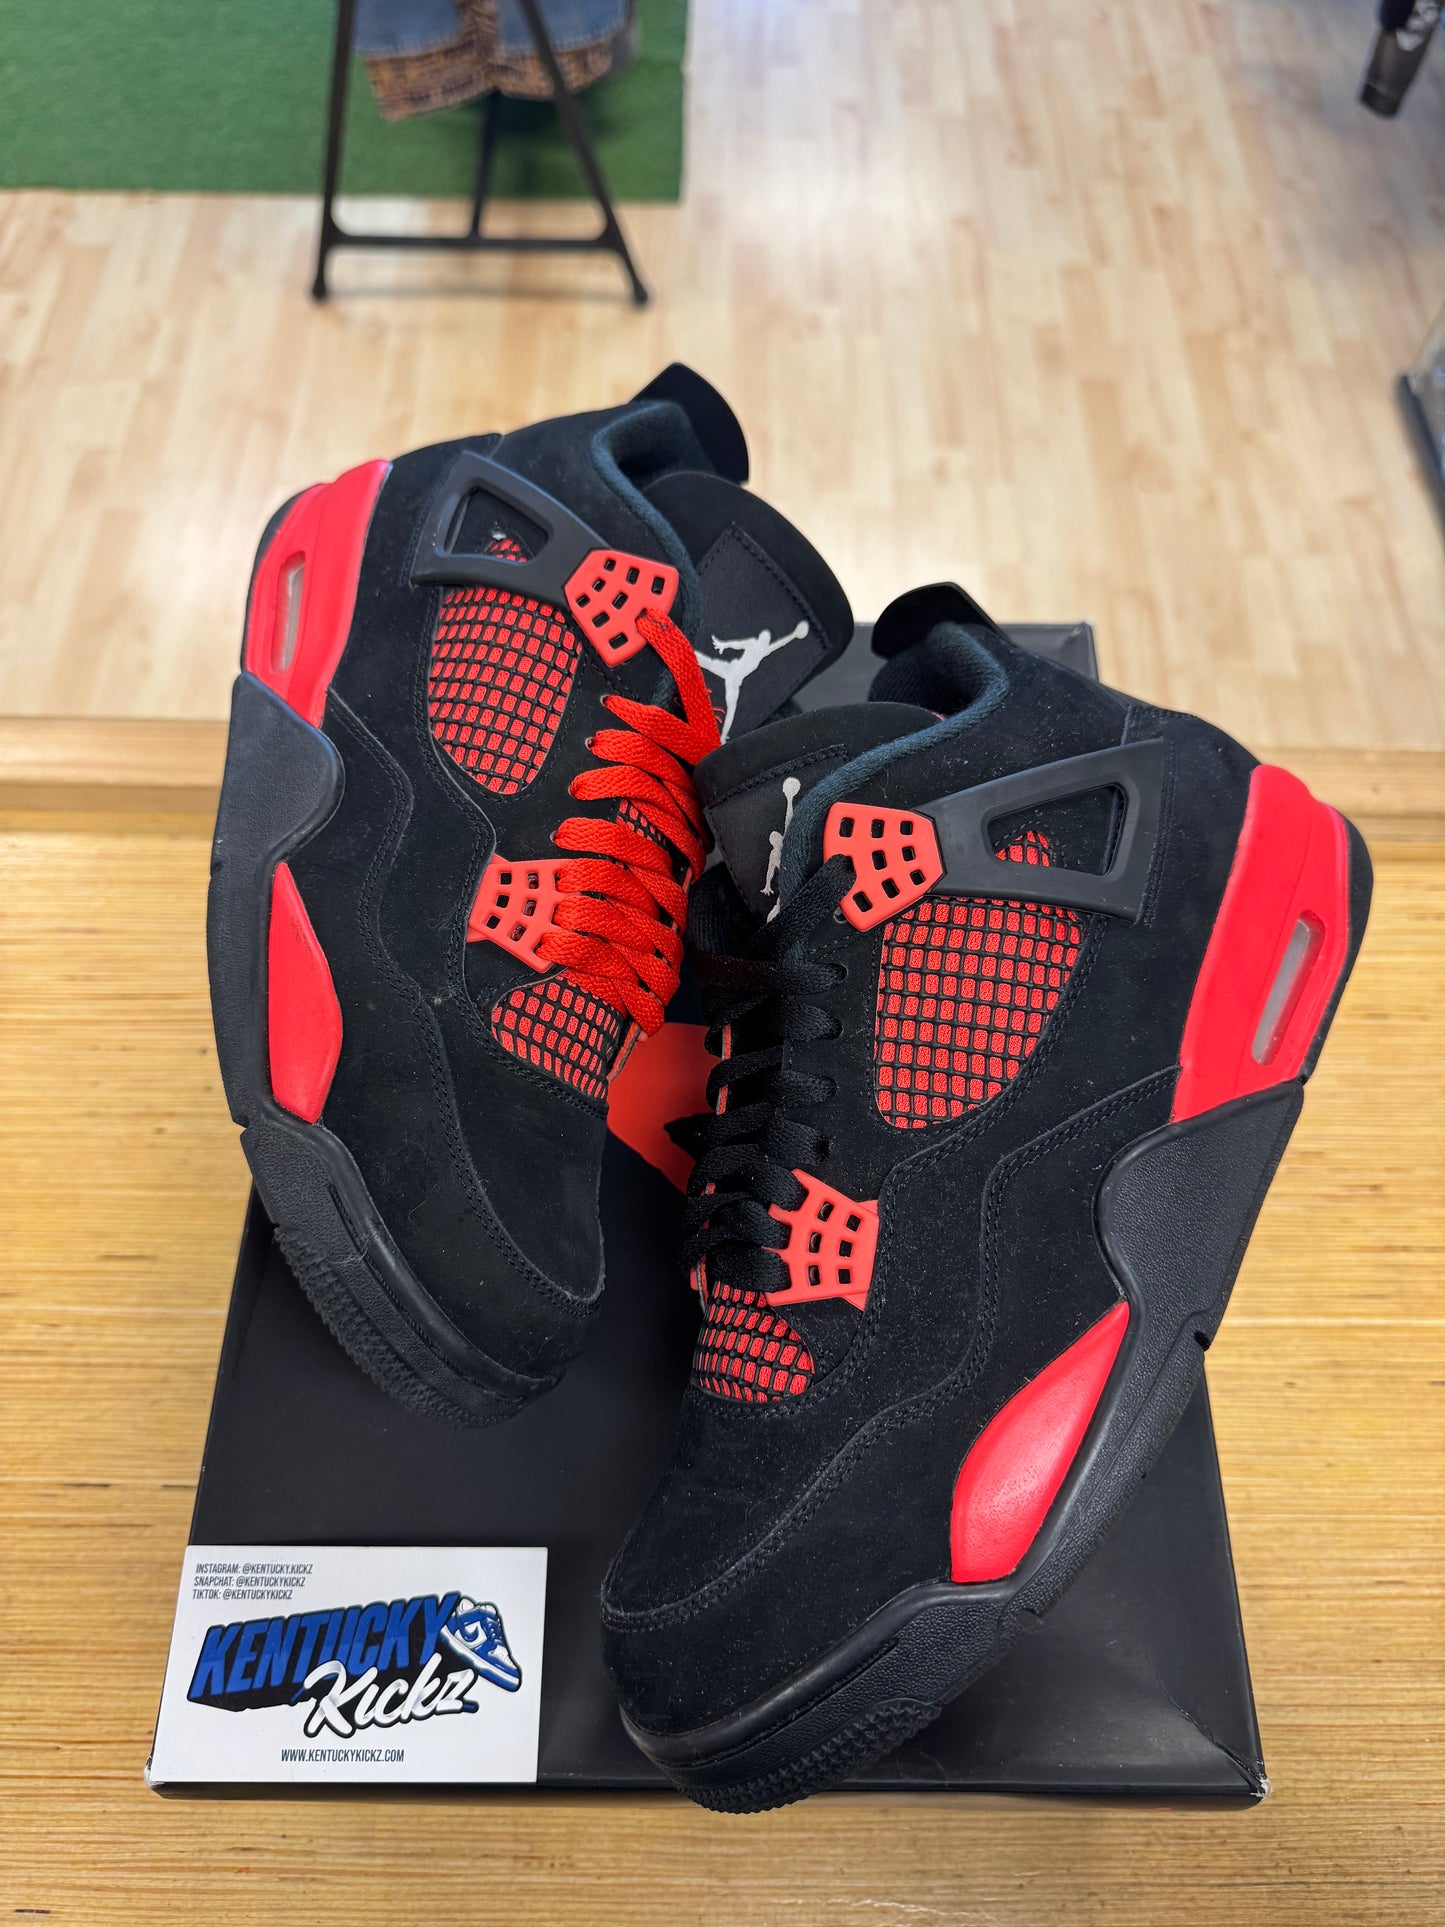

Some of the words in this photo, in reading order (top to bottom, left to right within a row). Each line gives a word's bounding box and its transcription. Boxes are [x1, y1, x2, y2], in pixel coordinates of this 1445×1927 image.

[196, 1563, 240, 1574] INSTAGRAM:
[242, 1563, 313, 1574] @KENTUCKY.KICKZ
[194, 1576, 234, 1586] SNAPCHAT:
[236, 1576, 305, 1587] @KENTUCKYKICKZ
[192, 1589, 221, 1599] TIKTOK:
[222, 1589, 292, 1600] @KENTUCKYKICKZ
[188, 1592, 460, 1702] KENTUCKY
[304, 1652, 475, 1737] Kickz
[281, 1749, 404, 1762] WWW.KENTUCKYKICKZ.COM
